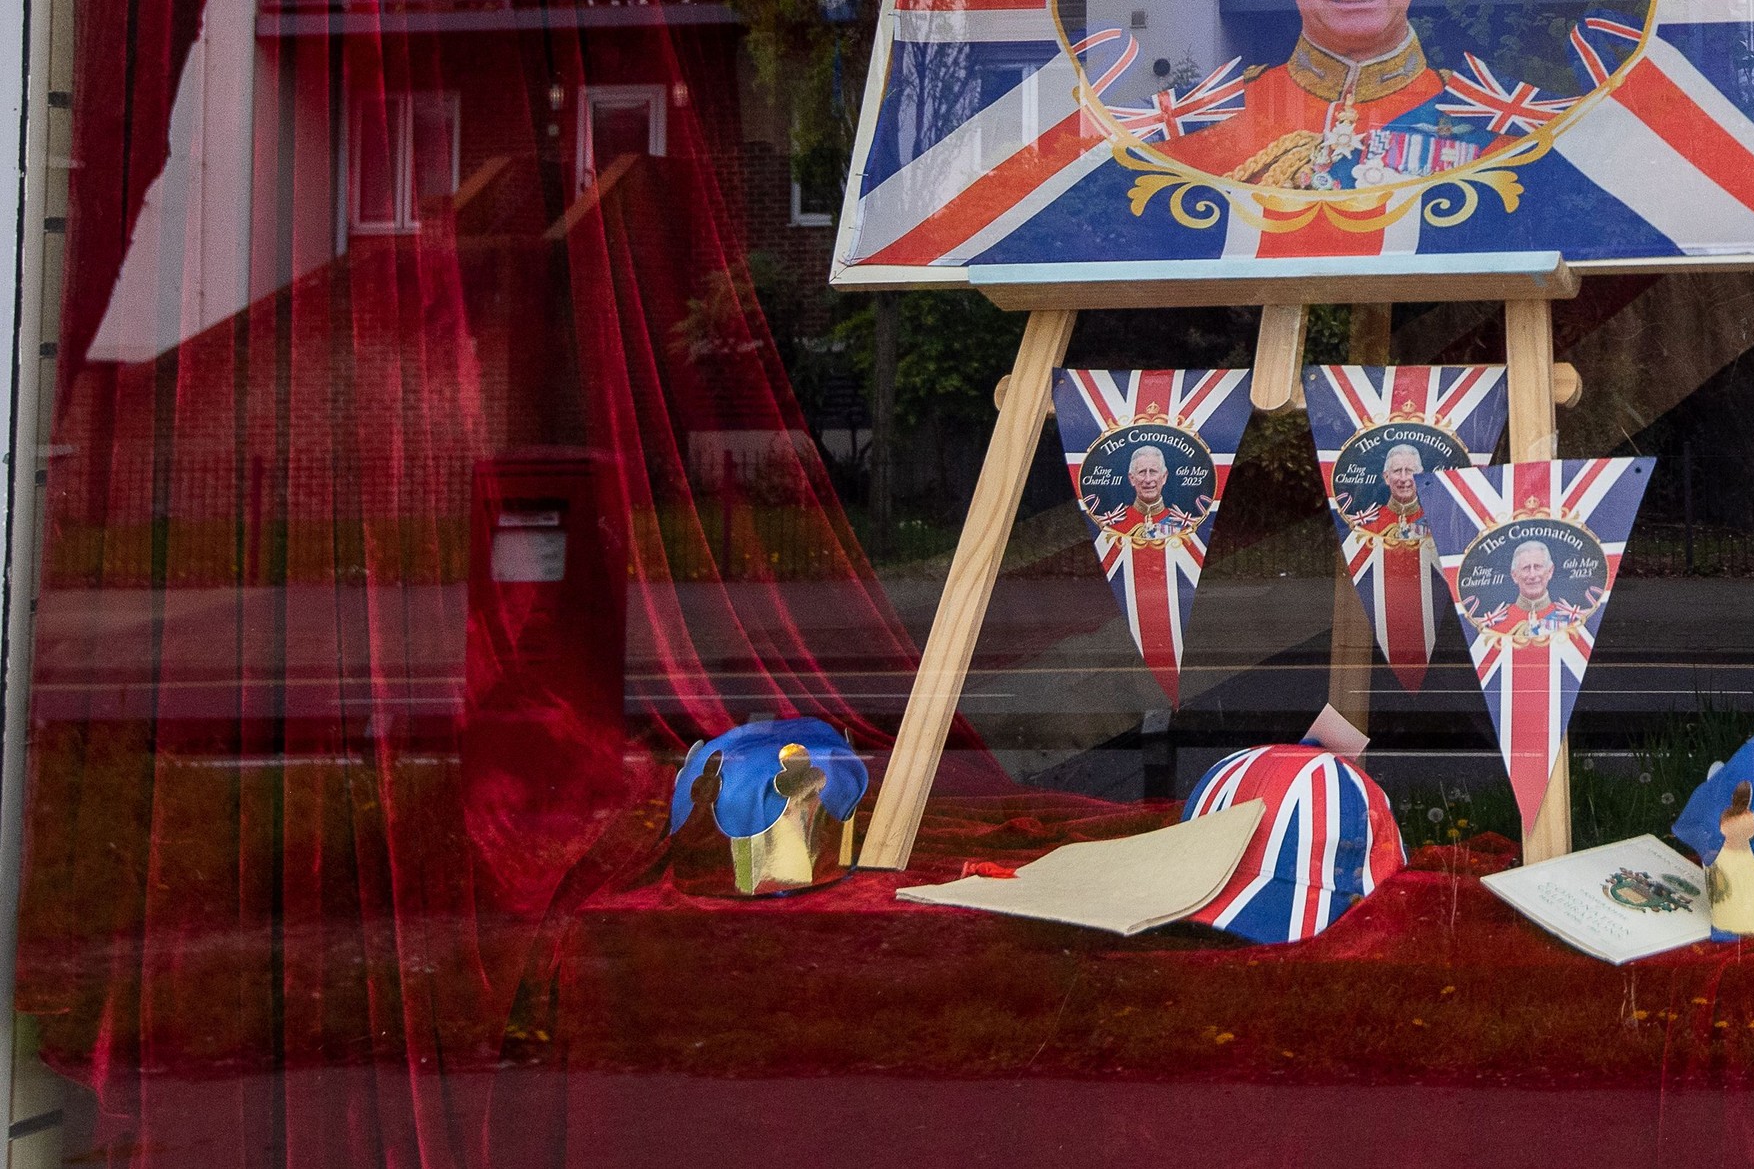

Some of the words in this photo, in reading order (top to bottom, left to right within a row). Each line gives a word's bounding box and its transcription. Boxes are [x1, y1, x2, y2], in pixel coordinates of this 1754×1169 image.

[1100, 437, 1126, 456] The
[1128, 429, 1196, 458] Coronation
[1354, 435, 1381, 453] The
[1383, 428, 1453, 458] Coronation
[1093, 465, 1112, 478] King
[1175, 465, 1189, 476] 6th
[1190, 465, 1209, 479] May
[1346, 463, 1367, 476] King
[1082, 475, 1110, 486] Charles
[1111, 475, 1123, 486] III
[1180, 476, 1203, 486] 2023
[1335, 473, 1364, 484] Charles
[1365, 474, 1377, 484] III
[1478, 534, 1506, 554] The
[1508, 525, 1584, 551] Coronation
[1562, 558, 1578, 569] 6th
[1579, 557, 1599, 569] May
[1472, 565, 1493, 577] King
[1461, 576, 1490, 588] Charles
[1491, 574, 1505, 585] III
